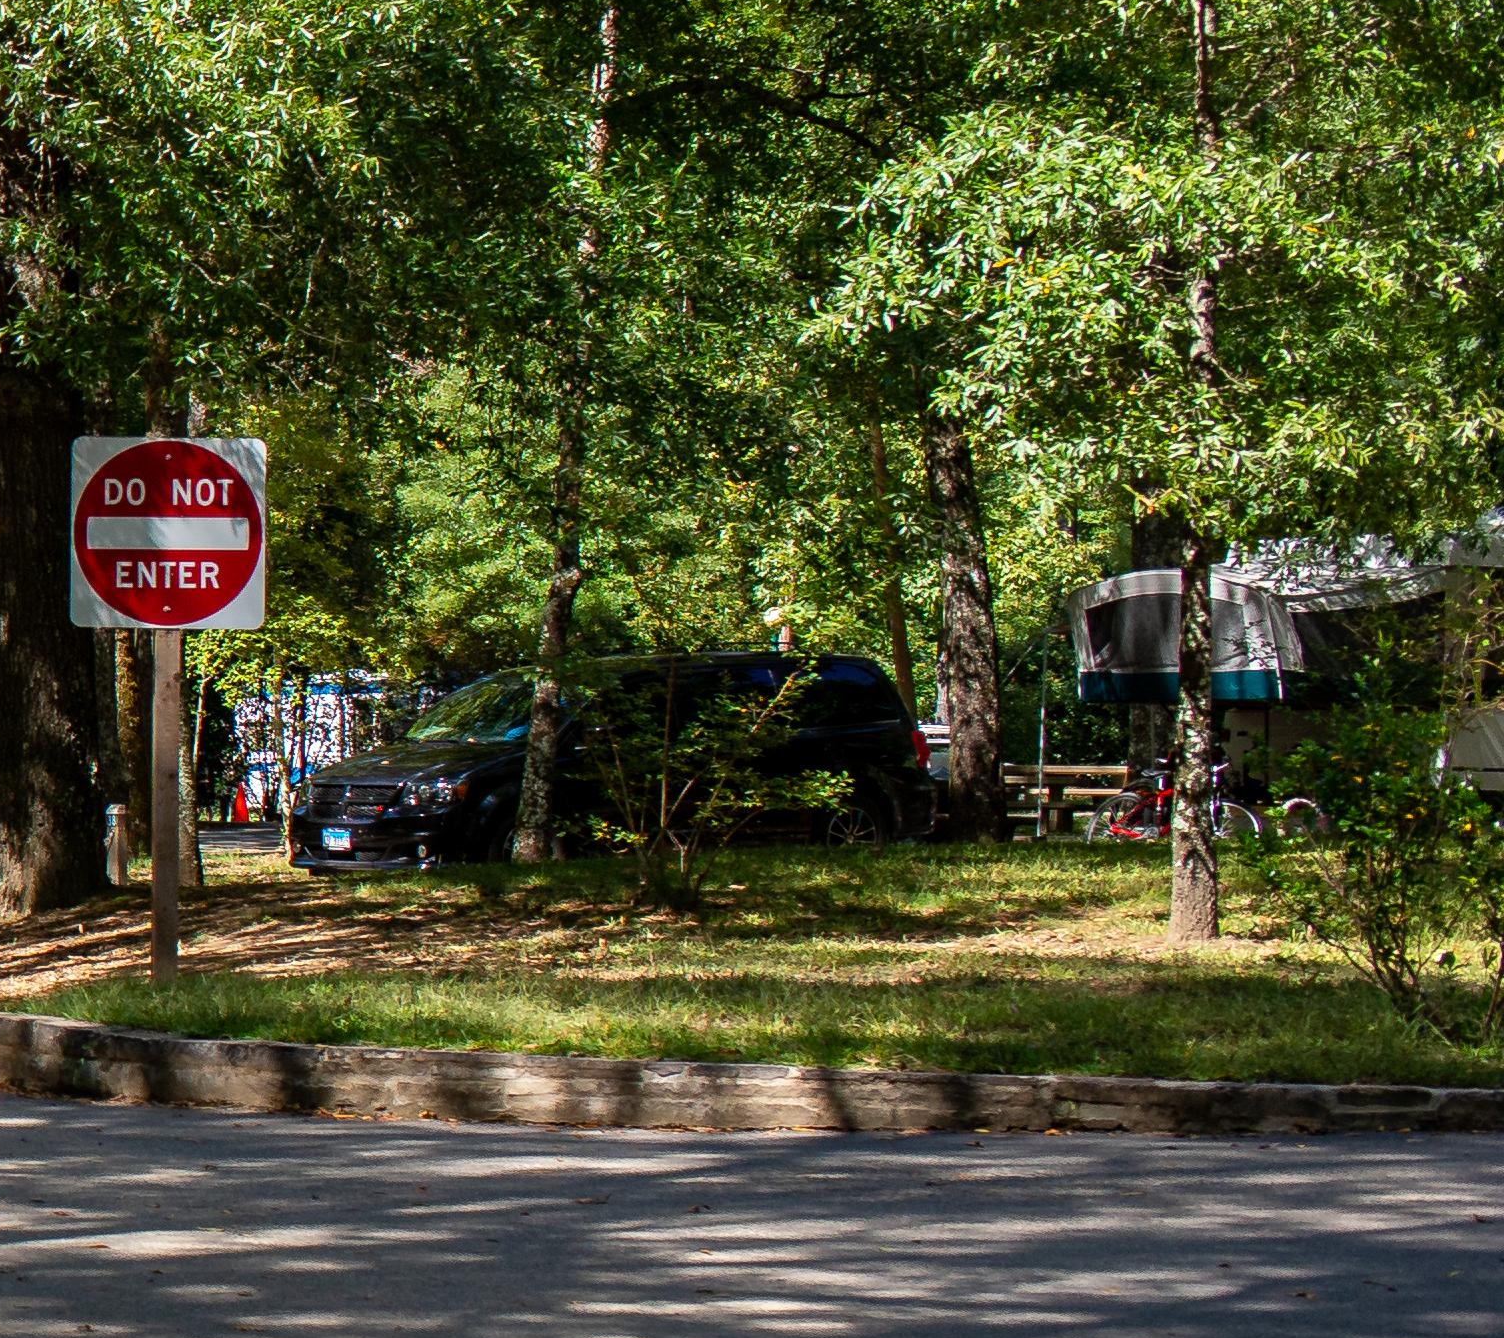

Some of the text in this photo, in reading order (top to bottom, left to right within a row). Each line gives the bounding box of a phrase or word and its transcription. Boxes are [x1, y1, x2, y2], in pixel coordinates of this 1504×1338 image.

[104, 478, 235, 506] DO NOT
[115, 561, 220, 589] ENTER
